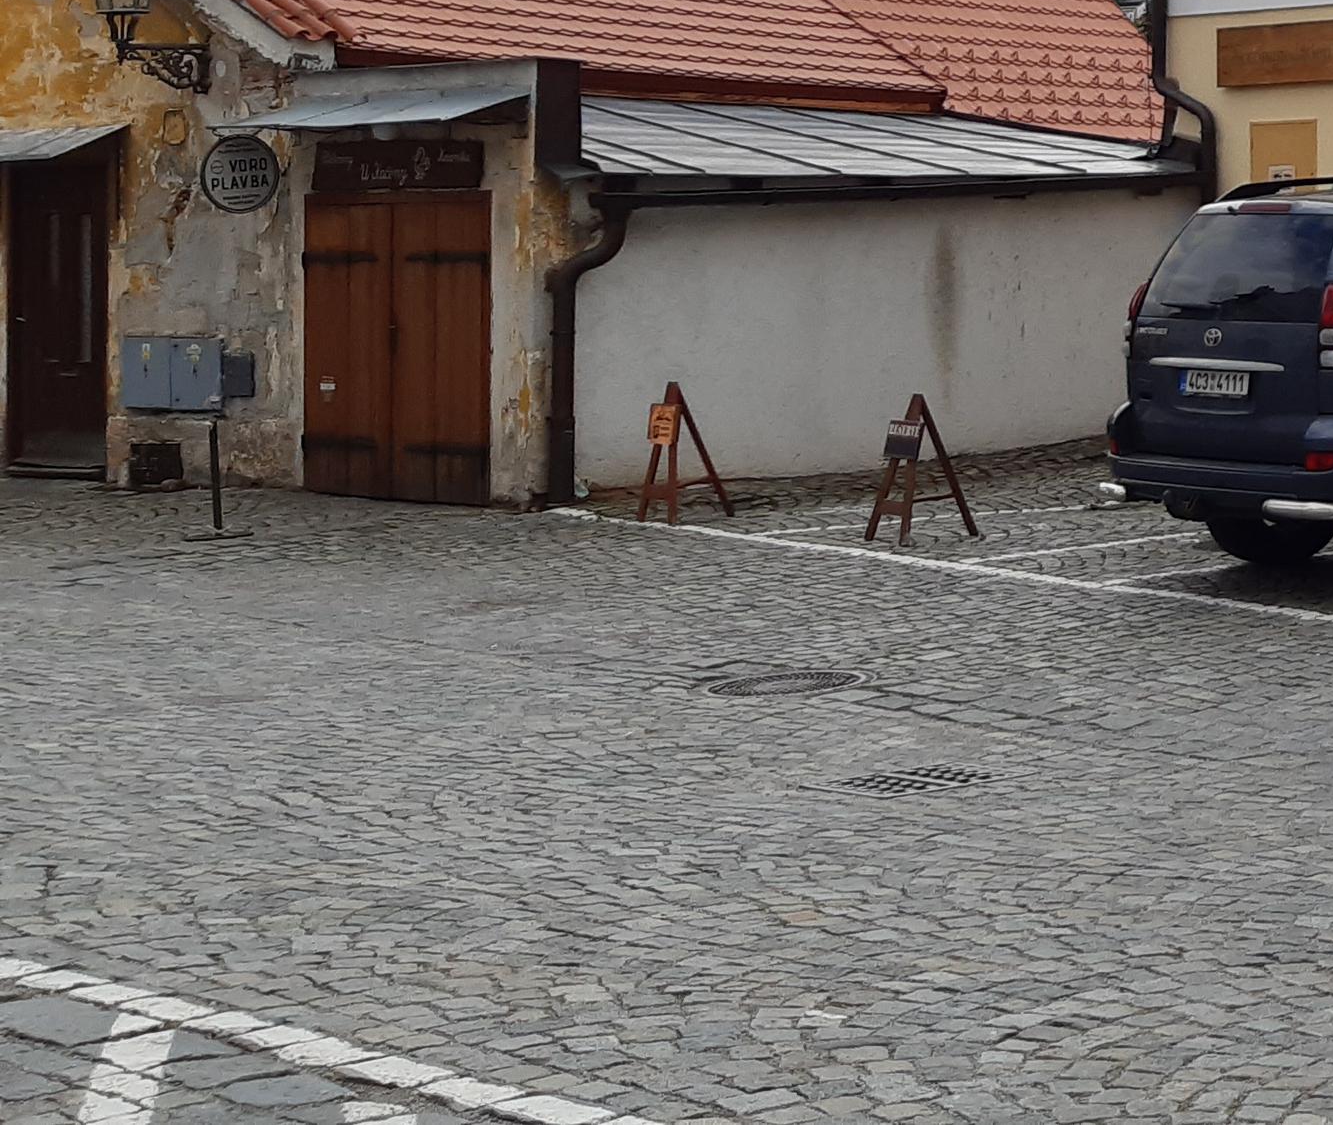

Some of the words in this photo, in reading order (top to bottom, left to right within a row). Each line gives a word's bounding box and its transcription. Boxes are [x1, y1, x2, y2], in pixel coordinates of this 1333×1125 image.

[229, 157, 267, 173] VORO
[211, 174, 269, 192] PLAVBA
[1188, 373, 1209, 391] 4C3
[1216, 373, 1245, 392] 4111
